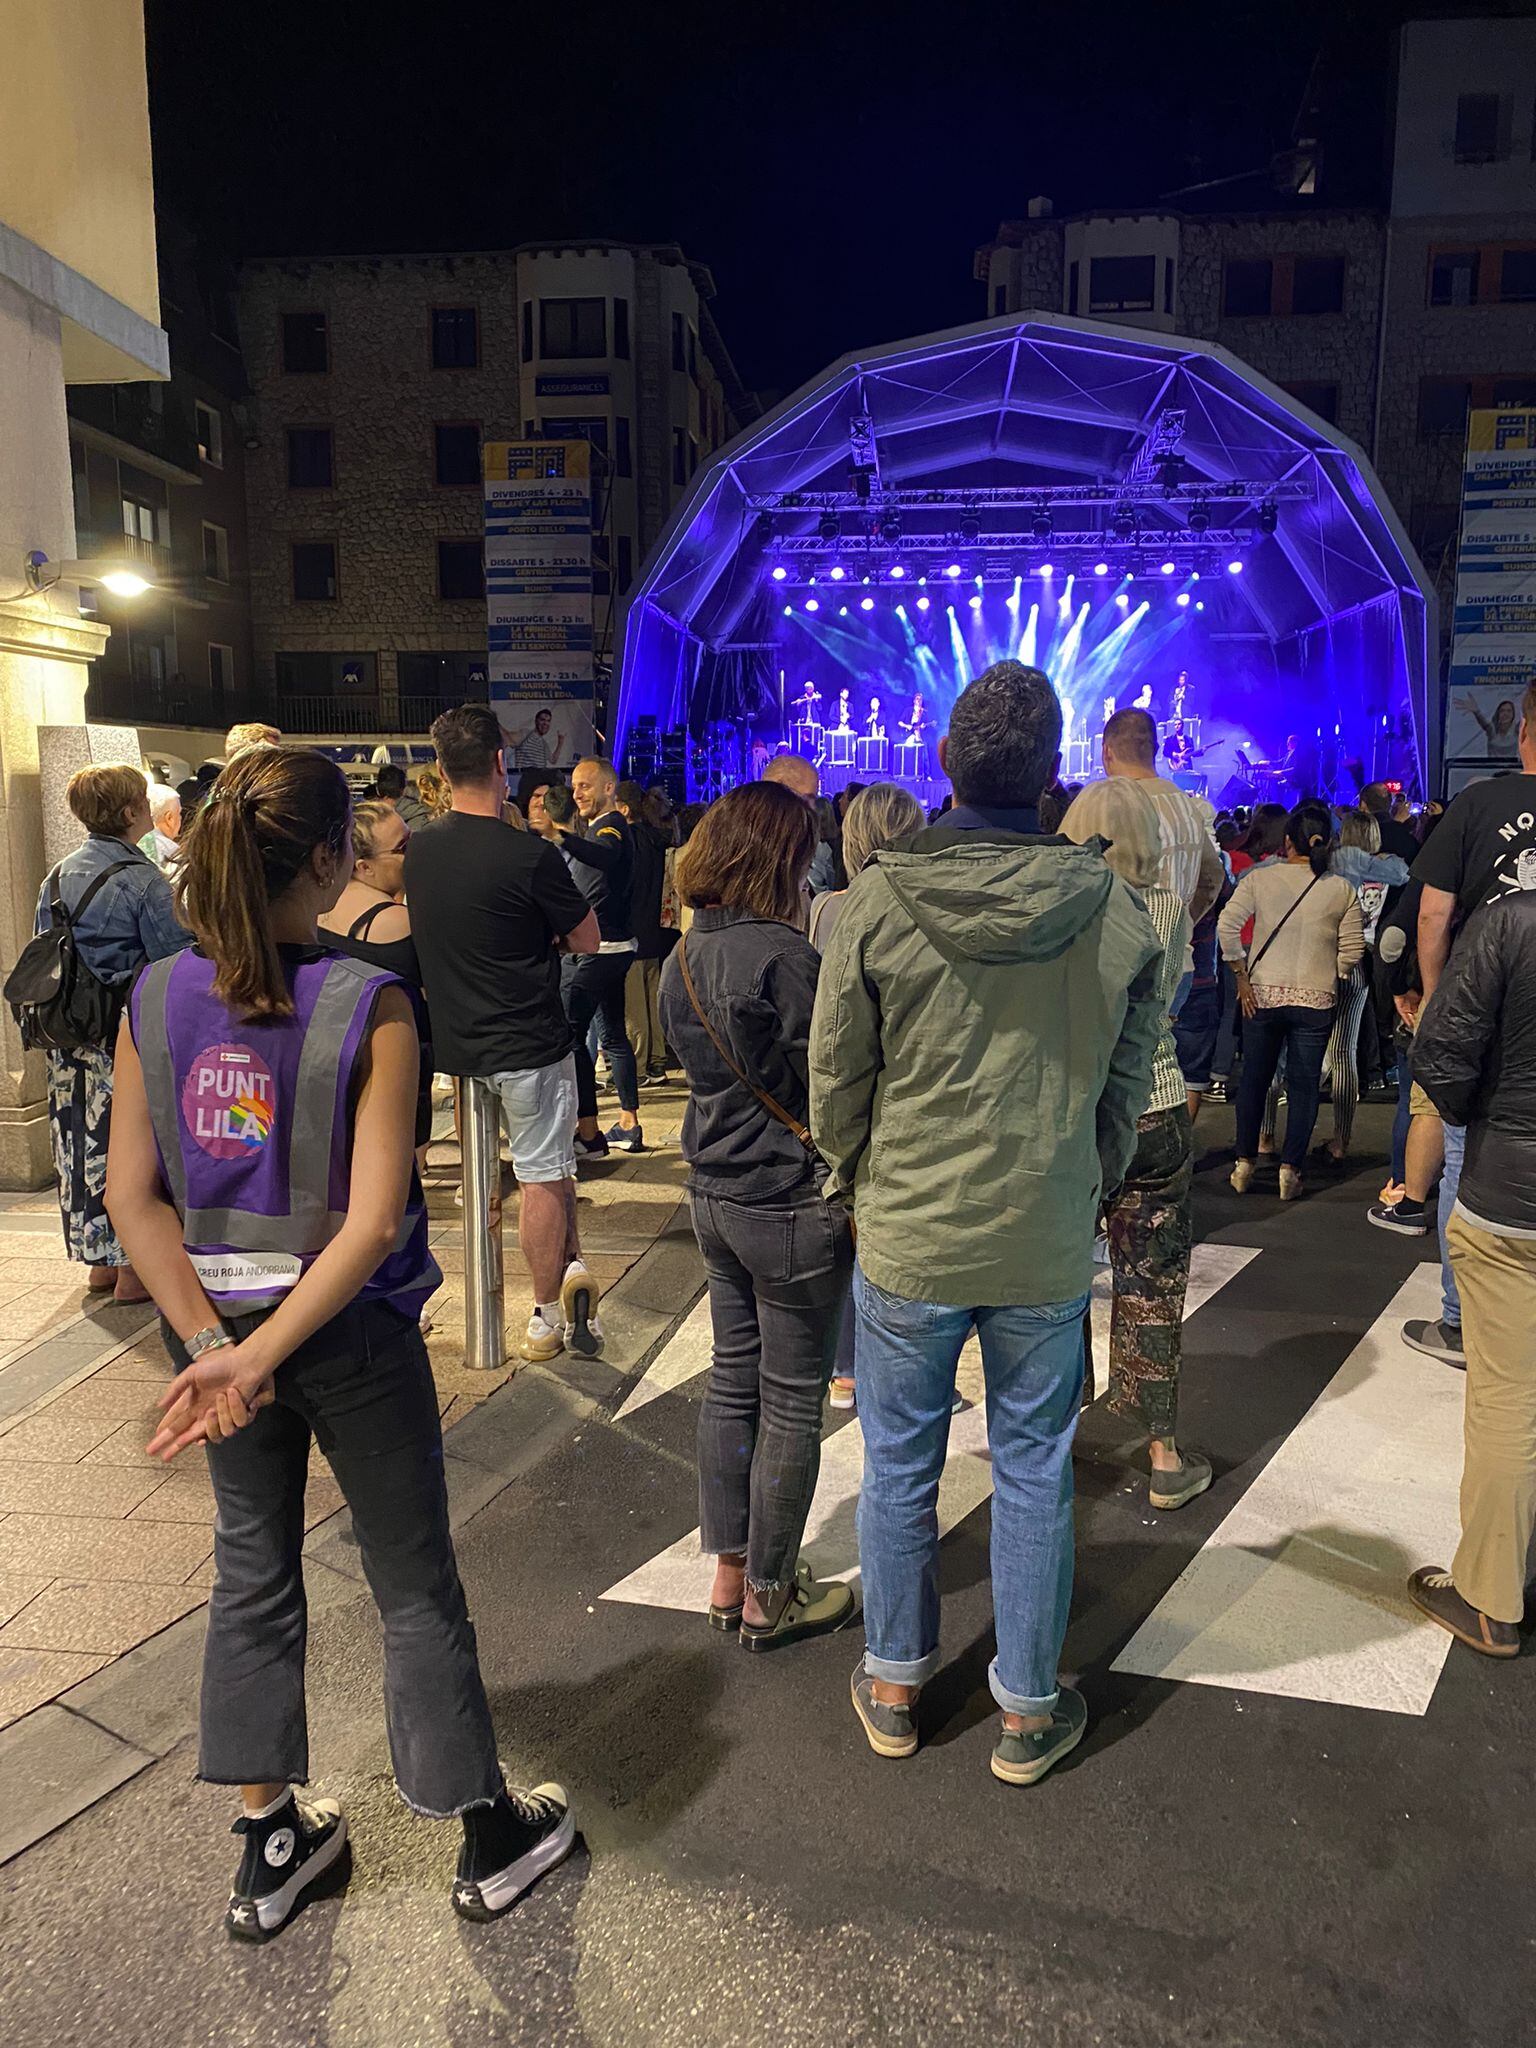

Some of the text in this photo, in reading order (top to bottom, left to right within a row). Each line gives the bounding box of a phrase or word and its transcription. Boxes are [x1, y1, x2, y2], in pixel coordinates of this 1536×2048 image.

[541, 383, 604, 393] ASSEGURANCES
[1524, 470, 1536, 478] LA
[1508, 481, 1536, 489] AZUL
[492, 489, 545, 498] DIVENDRES
[1467, 533, 1520, 543] DISSABTE
[1524, 533, 1530, 542] 5
[1494, 544, 1536, 552] GERTRU
[490, 558, 536, 566] DISSABTE
[538, 558, 544, 566] 5
[515, 568, 561, 576] GERTRUDIS
[1466, 594, 1533, 603] DIUMENGE 6
[1499, 605, 1536, 613] PRINCIP
[496, 615, 545, 623] DIUMENGE
[547, 615, 553, 623] 6
[562, 615, 572, 623] 23
[1469, 655, 1515, 664] DILLUNS
[503, 672, 543, 680] DILLUNS
[197, 1067, 271, 1102] PUNT
[195, 1107, 262, 1142] LILA
[221, 1265, 244, 1278] ROJA
[245, 1263, 296, 1276] ANDORRANA
